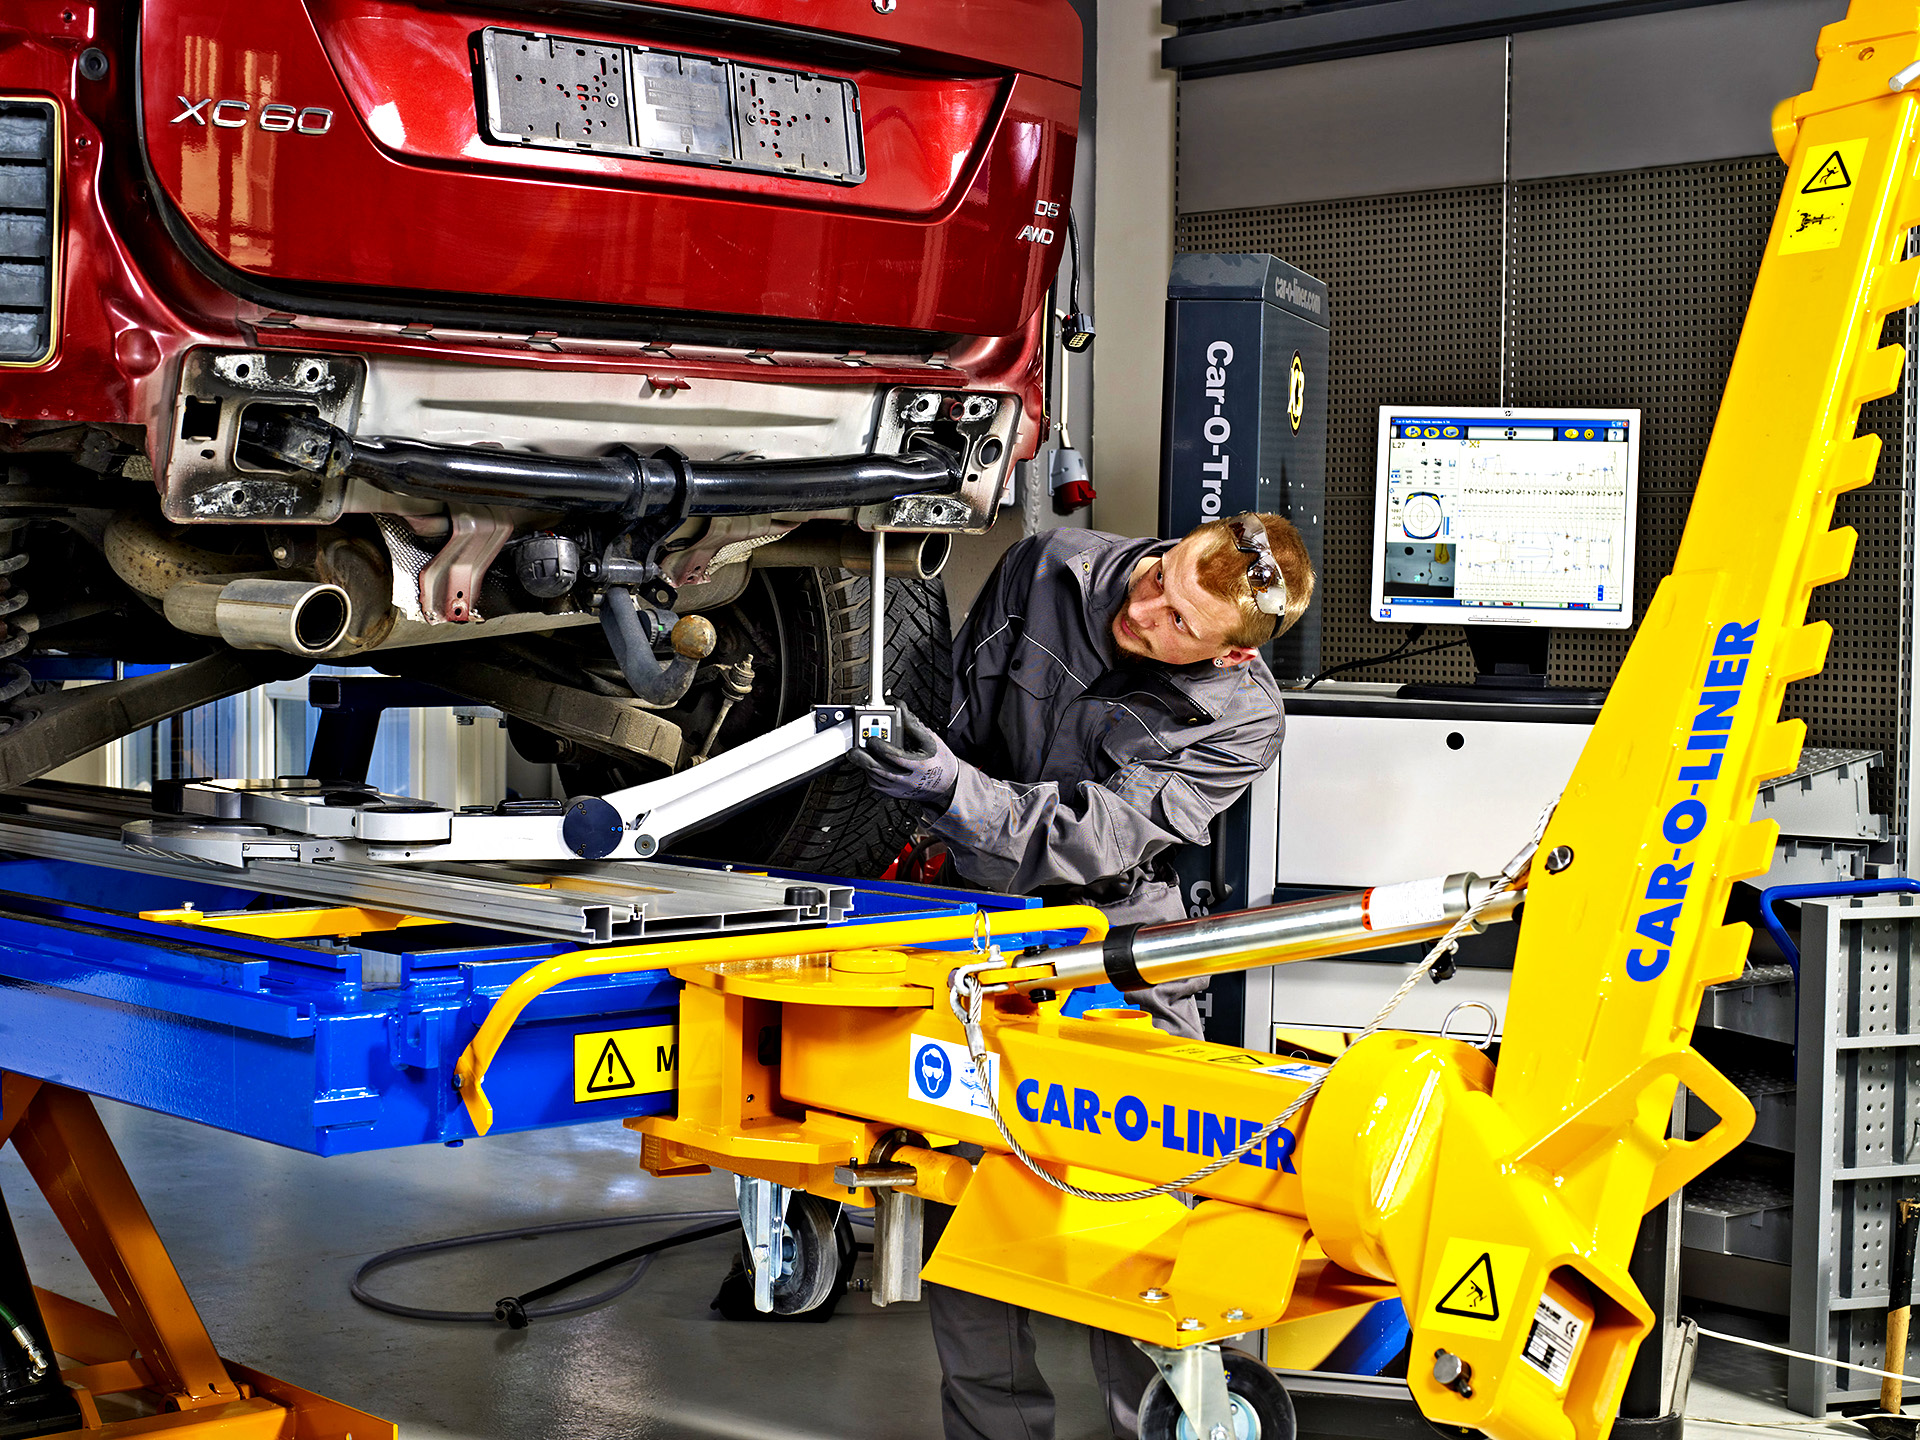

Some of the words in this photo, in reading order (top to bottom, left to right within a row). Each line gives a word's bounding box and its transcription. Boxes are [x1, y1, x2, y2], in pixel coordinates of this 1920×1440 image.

[1034, 199, 1060, 218] D5
[1016, 224, 1055, 245] AWD
[1275, 276, 1321, 315] car-o-liner.com
[1625, 618, 1761, 982] CAR-O-LINER
[1015, 1078, 1298, 1175] CAR-O-LINER
